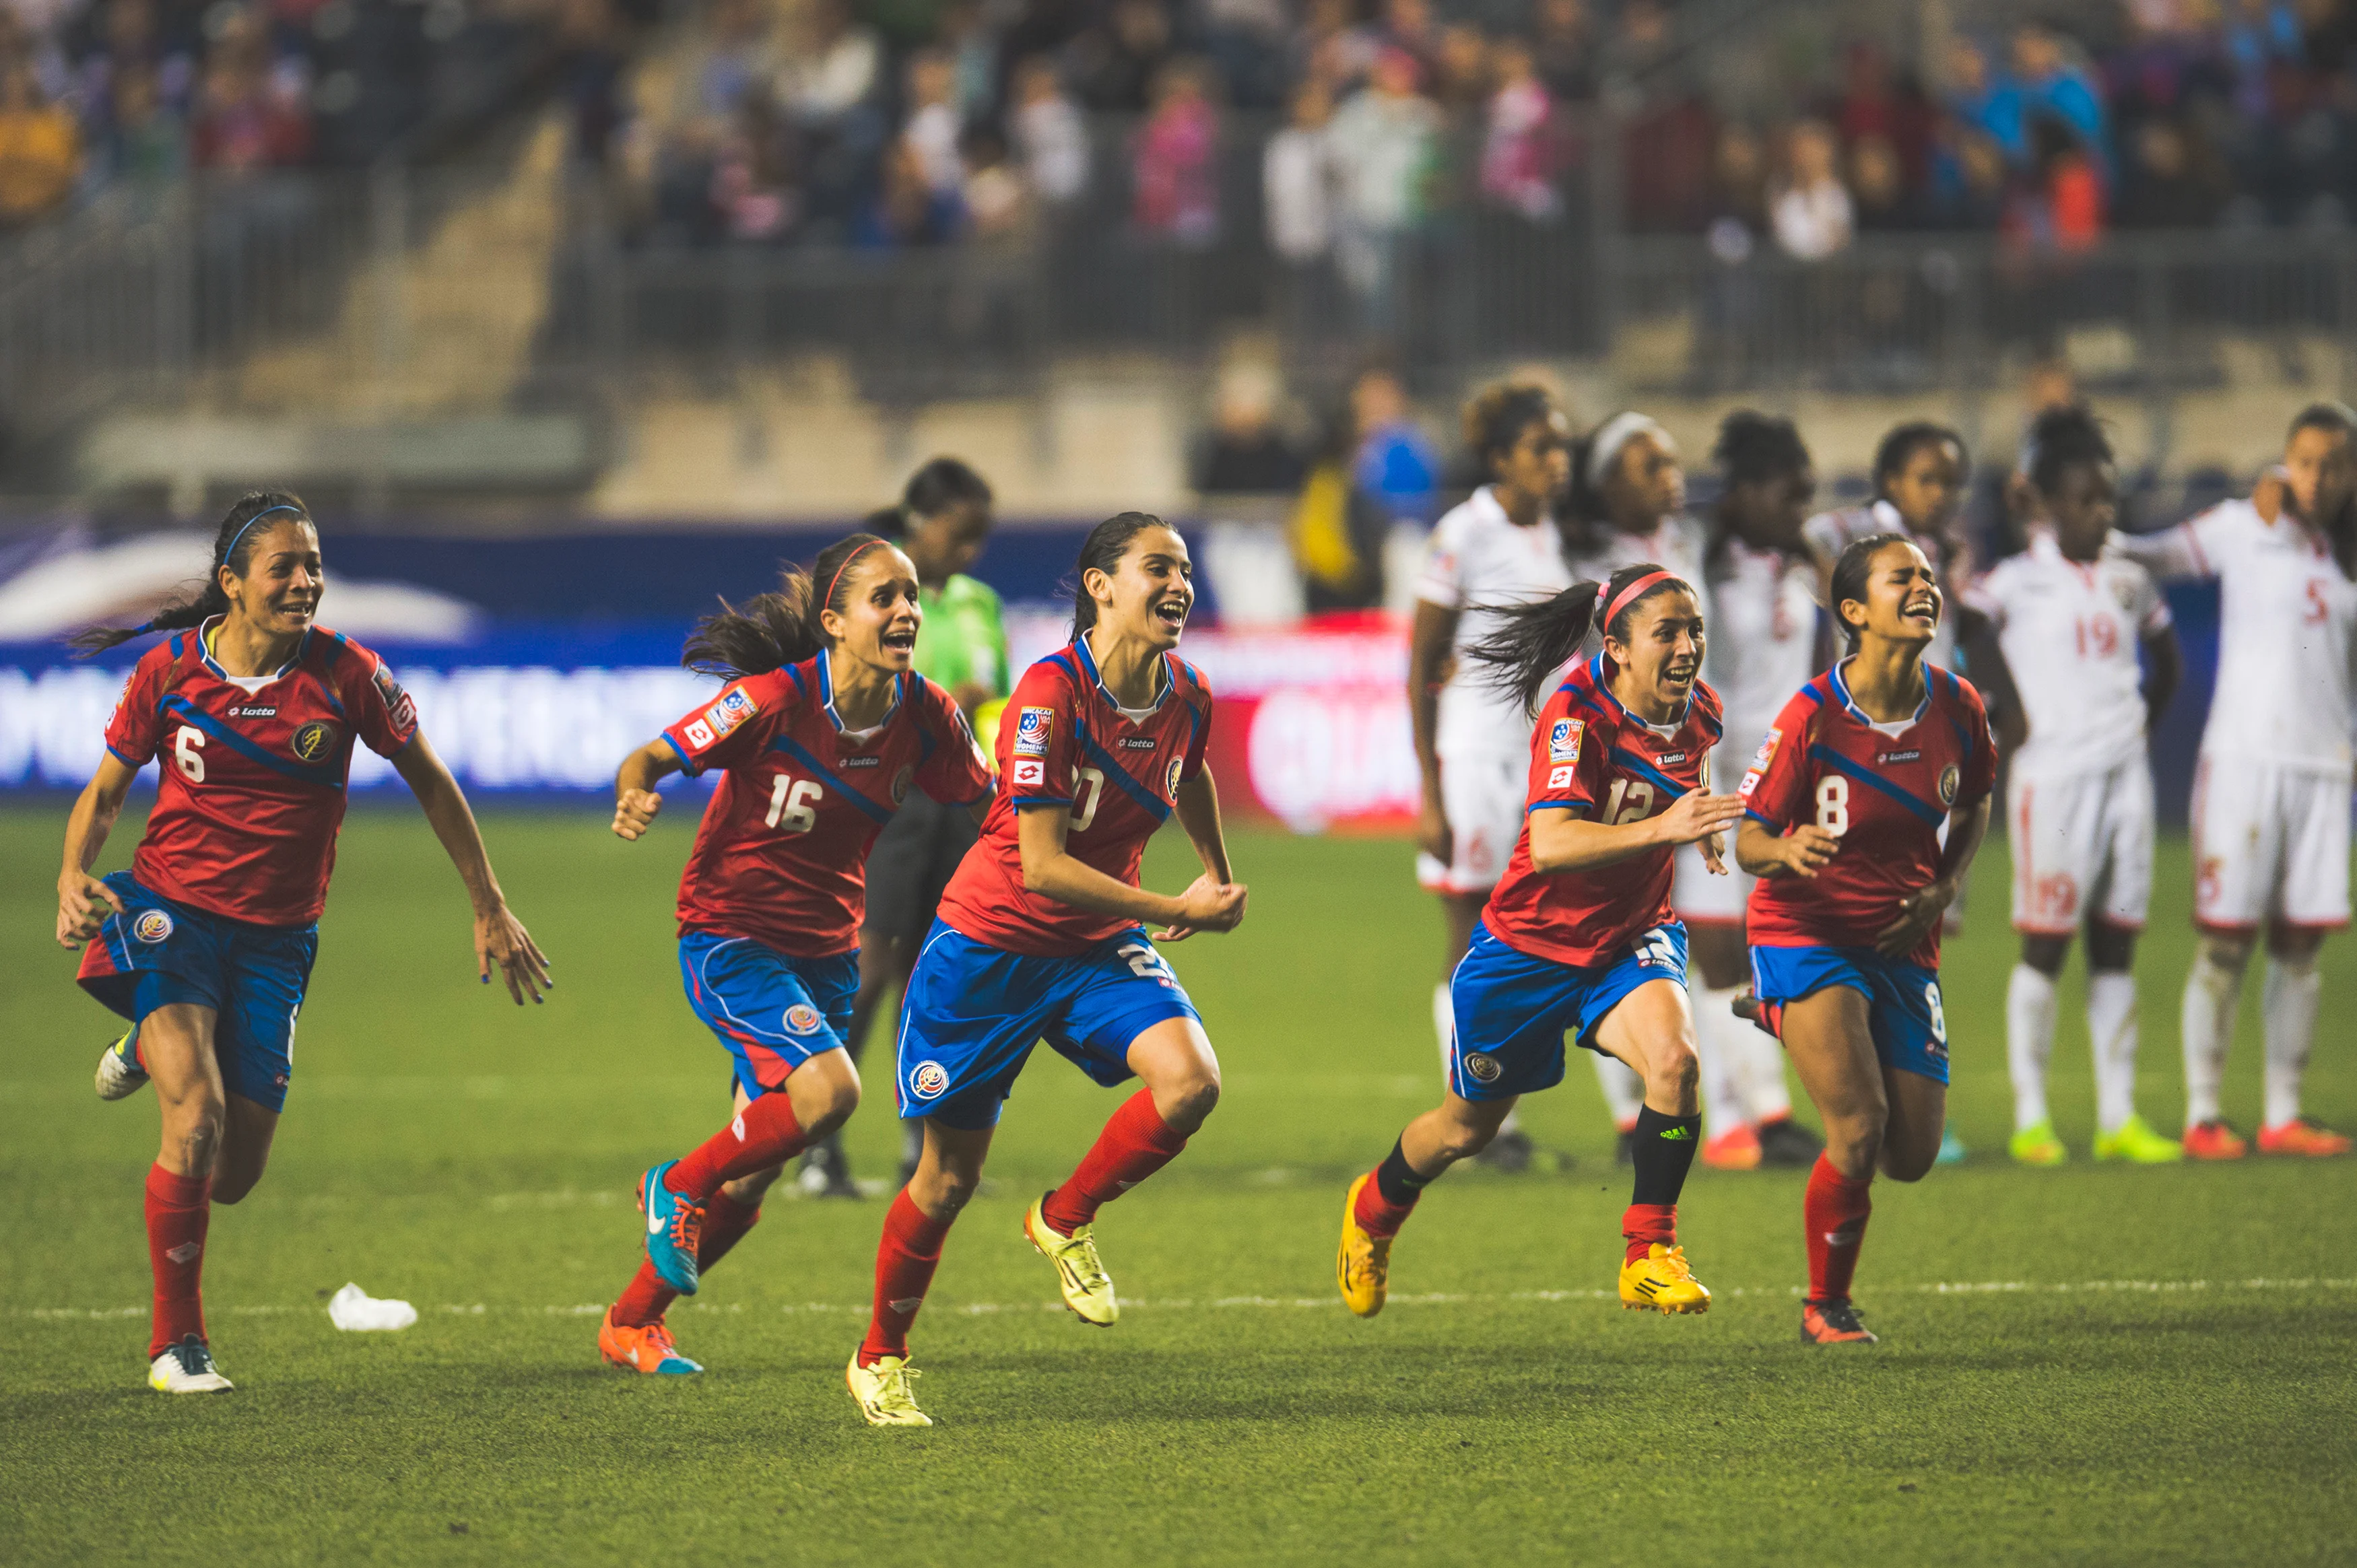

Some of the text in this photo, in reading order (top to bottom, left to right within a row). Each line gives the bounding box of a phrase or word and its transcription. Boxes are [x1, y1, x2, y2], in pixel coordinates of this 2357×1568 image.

[2303, 578, 2329, 627] 5
[2073, 613, 2119, 660] 19
[241, 707, 276, 716] lotto
[175, 725, 205, 783] 6
[849, 757, 878, 766] lotto
[1127, 738, 1154, 748] lotto
[1663, 753, 1685, 763] lotto
[765, 774, 823, 832] 16
[1069, 764, 1104, 831] 0
[1600, 778, 1654, 825] 12
[1816, 775, 1849, 837] 8
[2037, 873, 2078, 916] 19
[1632, 928, 1680, 969] 12
[1925, 982, 1946, 1044] 8
